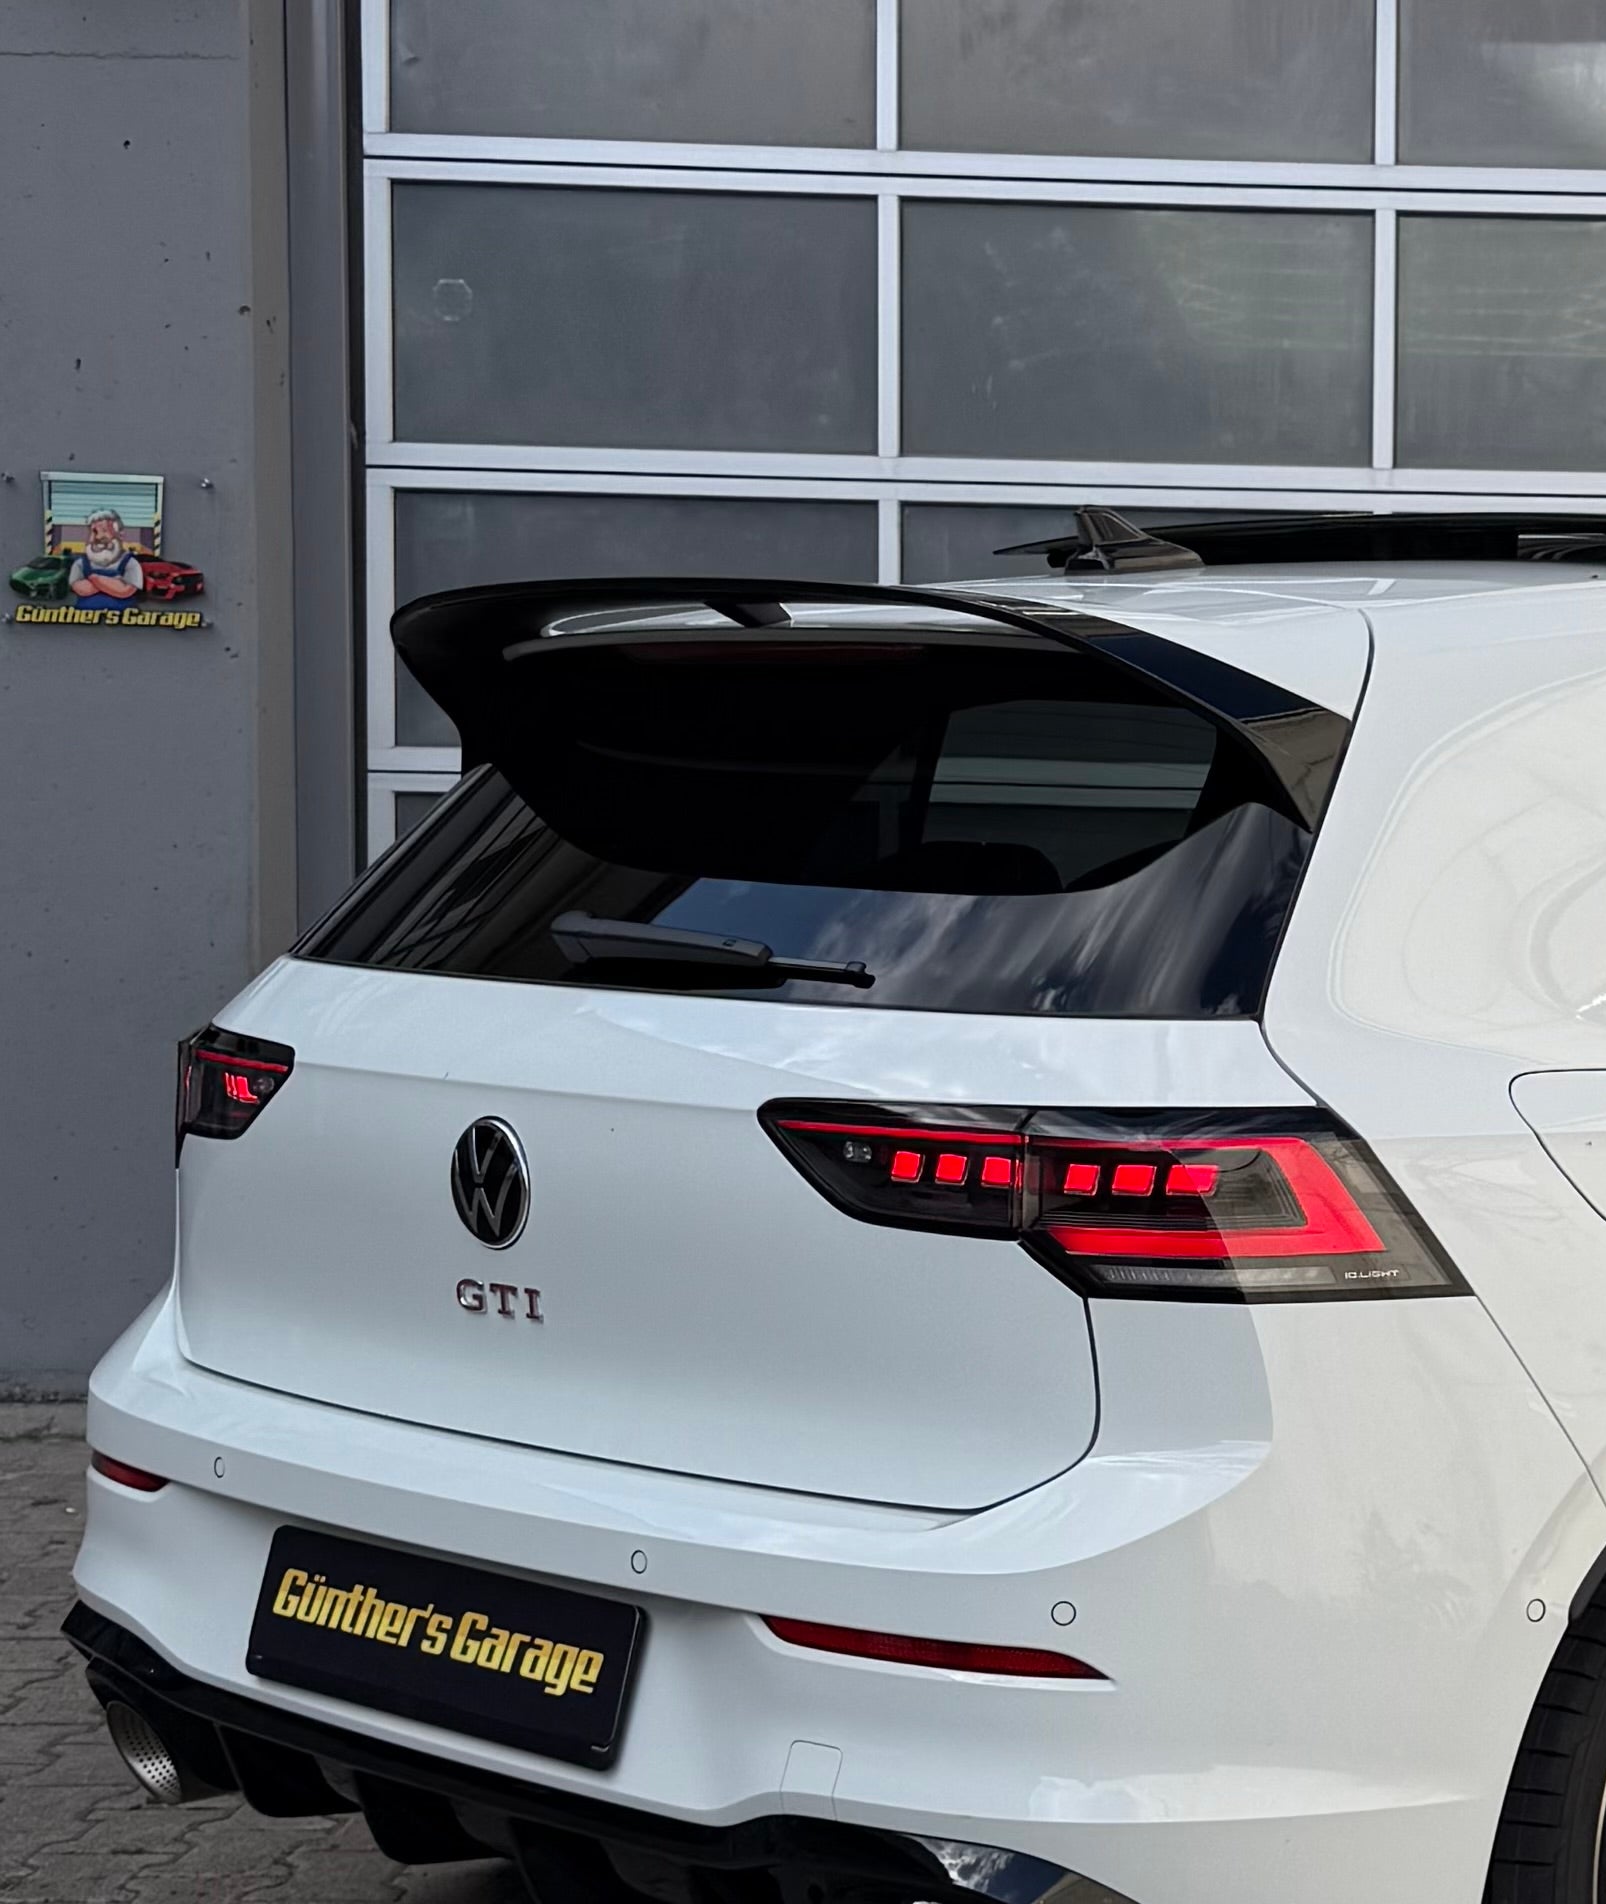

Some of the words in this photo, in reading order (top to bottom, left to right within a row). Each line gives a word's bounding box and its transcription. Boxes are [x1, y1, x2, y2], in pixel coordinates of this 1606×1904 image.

[15, 604, 121, 625] Günther's
[121, 607, 202, 630] Garage
[456, 1278, 544, 1324] GTI
[272, 1567, 453, 1656] Günther's
[450, 1611, 604, 1696] Garage
